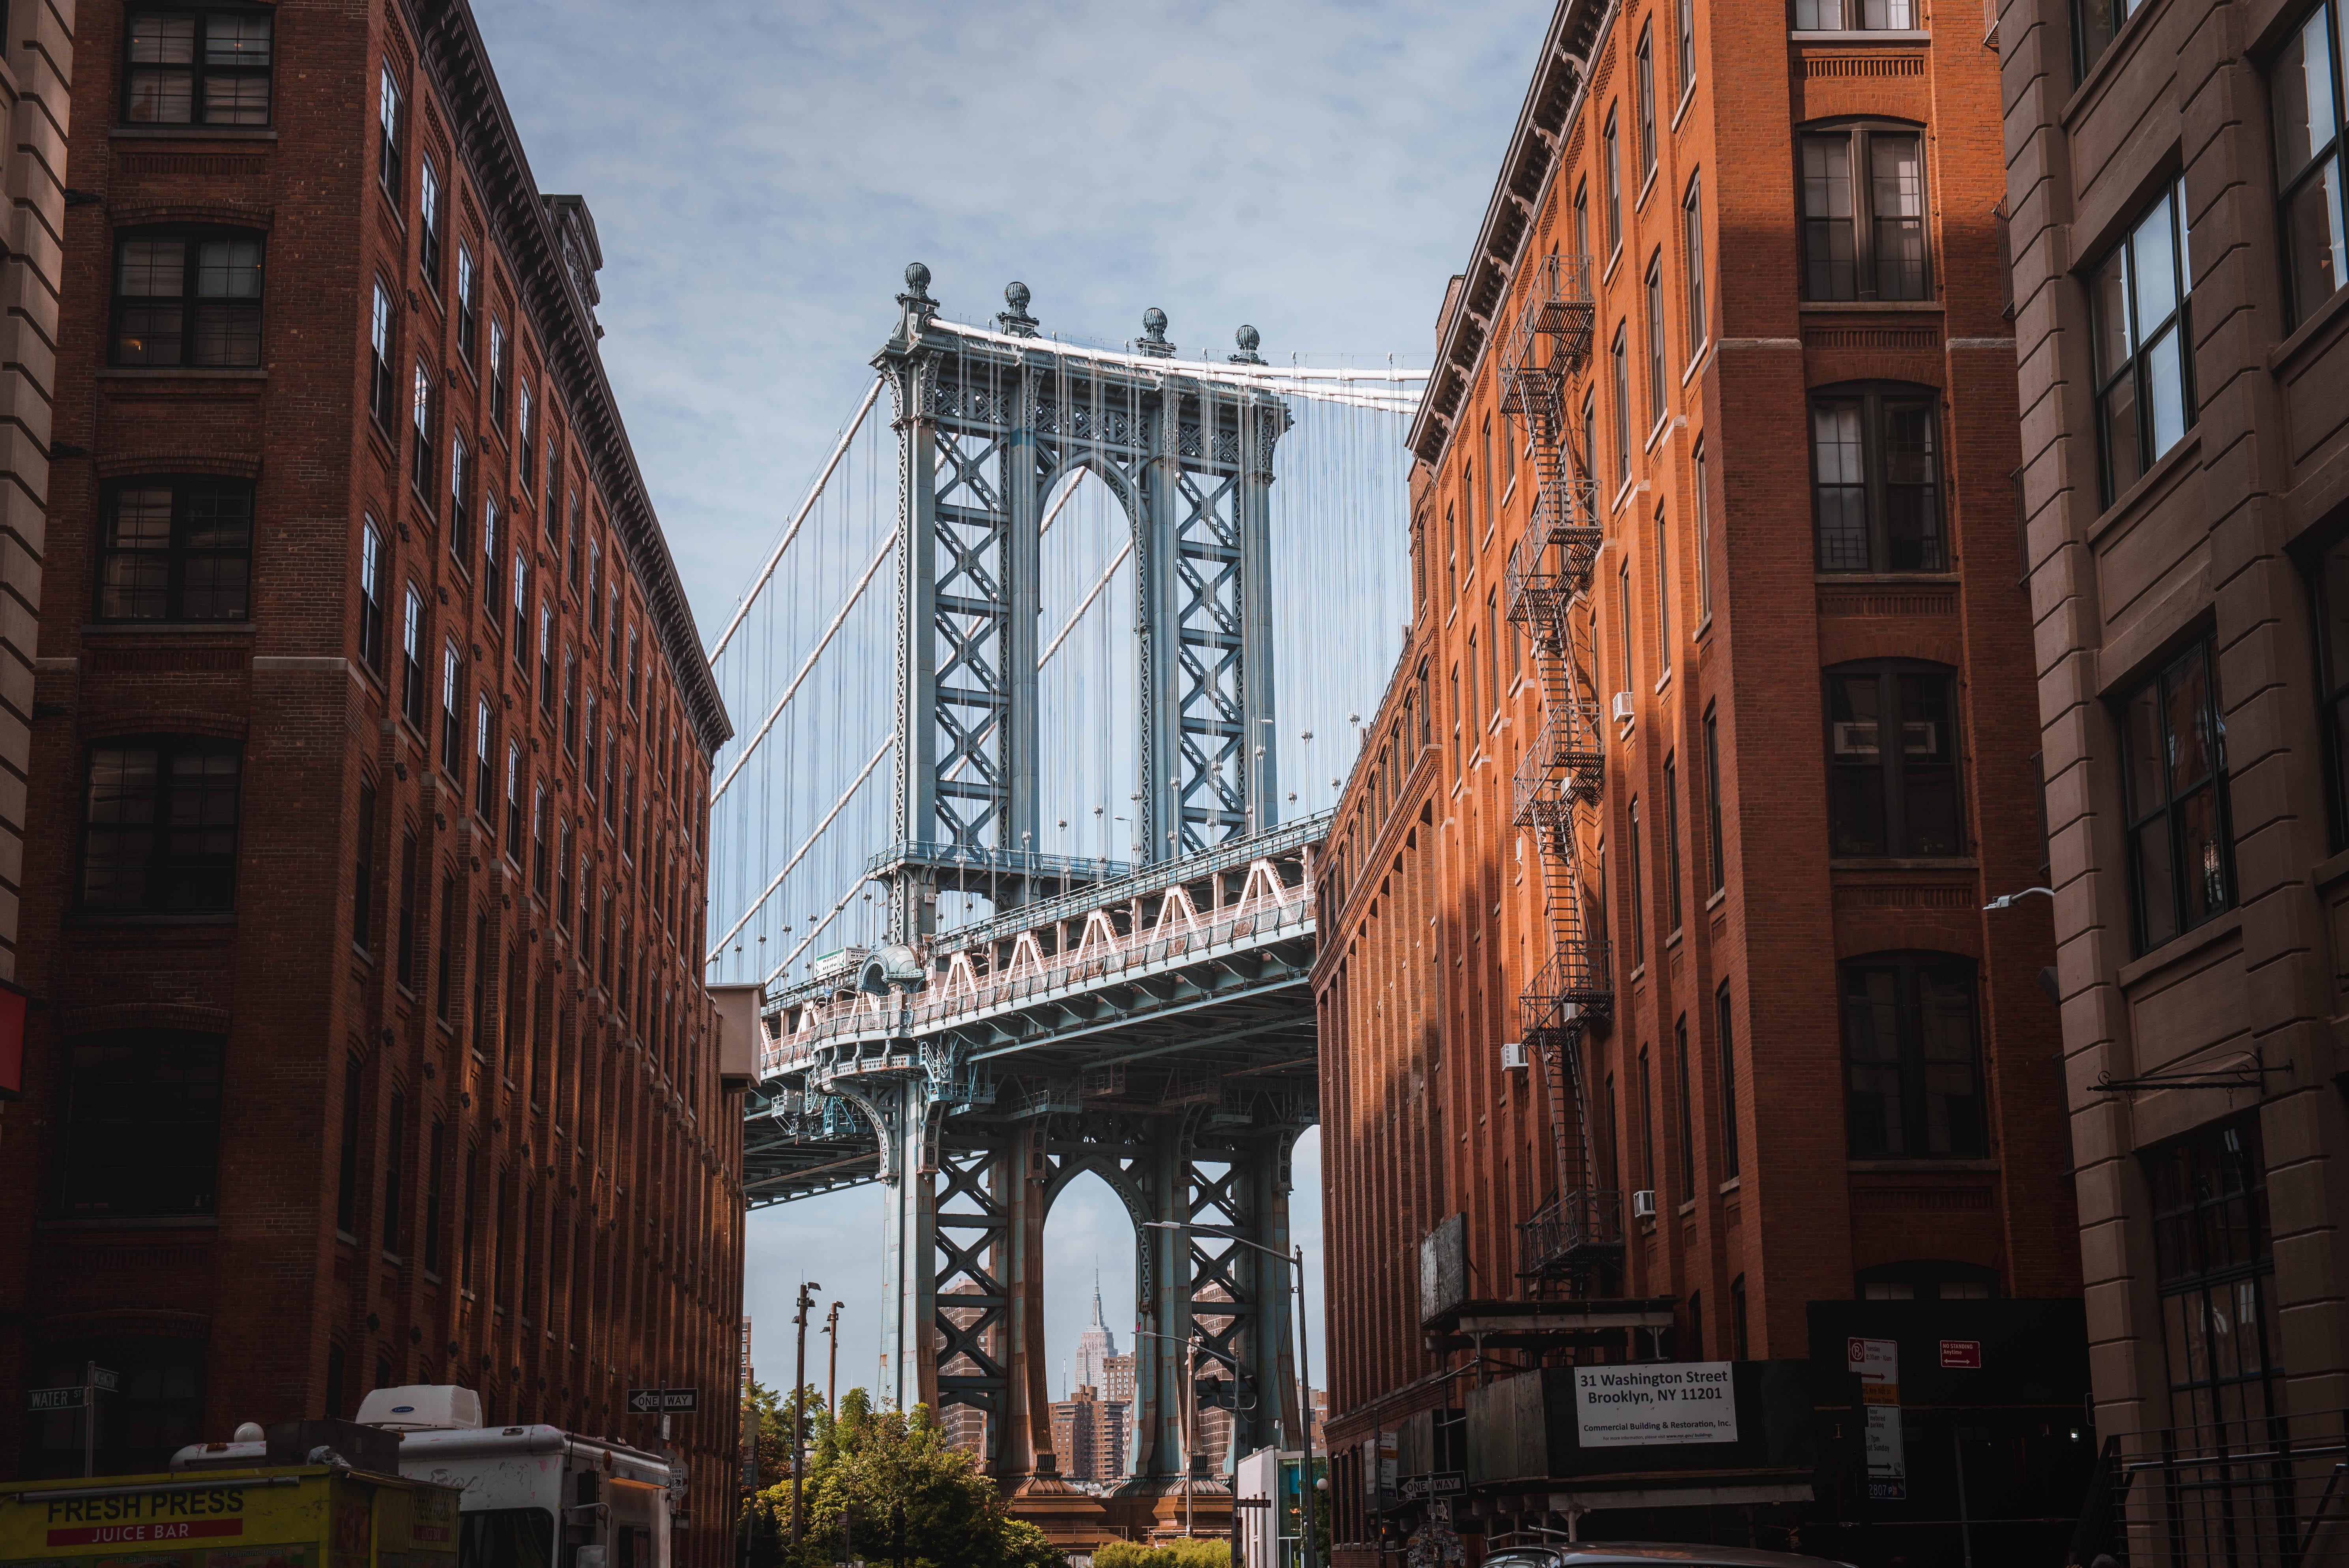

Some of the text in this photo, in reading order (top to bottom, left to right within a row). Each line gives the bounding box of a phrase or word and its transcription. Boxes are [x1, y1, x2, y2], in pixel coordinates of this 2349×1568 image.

[1580, 1371, 1728, 1387] 31 Washington Street
[32, 1390, 82, 1407] WATER ST
[639, 1396, 688, 1405] ONE WAY
[1588, 1388, 1722, 1404] Brooklyn, NY 11201
[1874, 1444, 1889, 1453] Sunday
[1407, 1479, 1456, 1492] ONE WAY
[1869, 1484, 1887, 1495] 2807
[48, 1488, 243, 1523] FRESH PRESS
[92, 1523, 189, 1542] JUICE BAR
